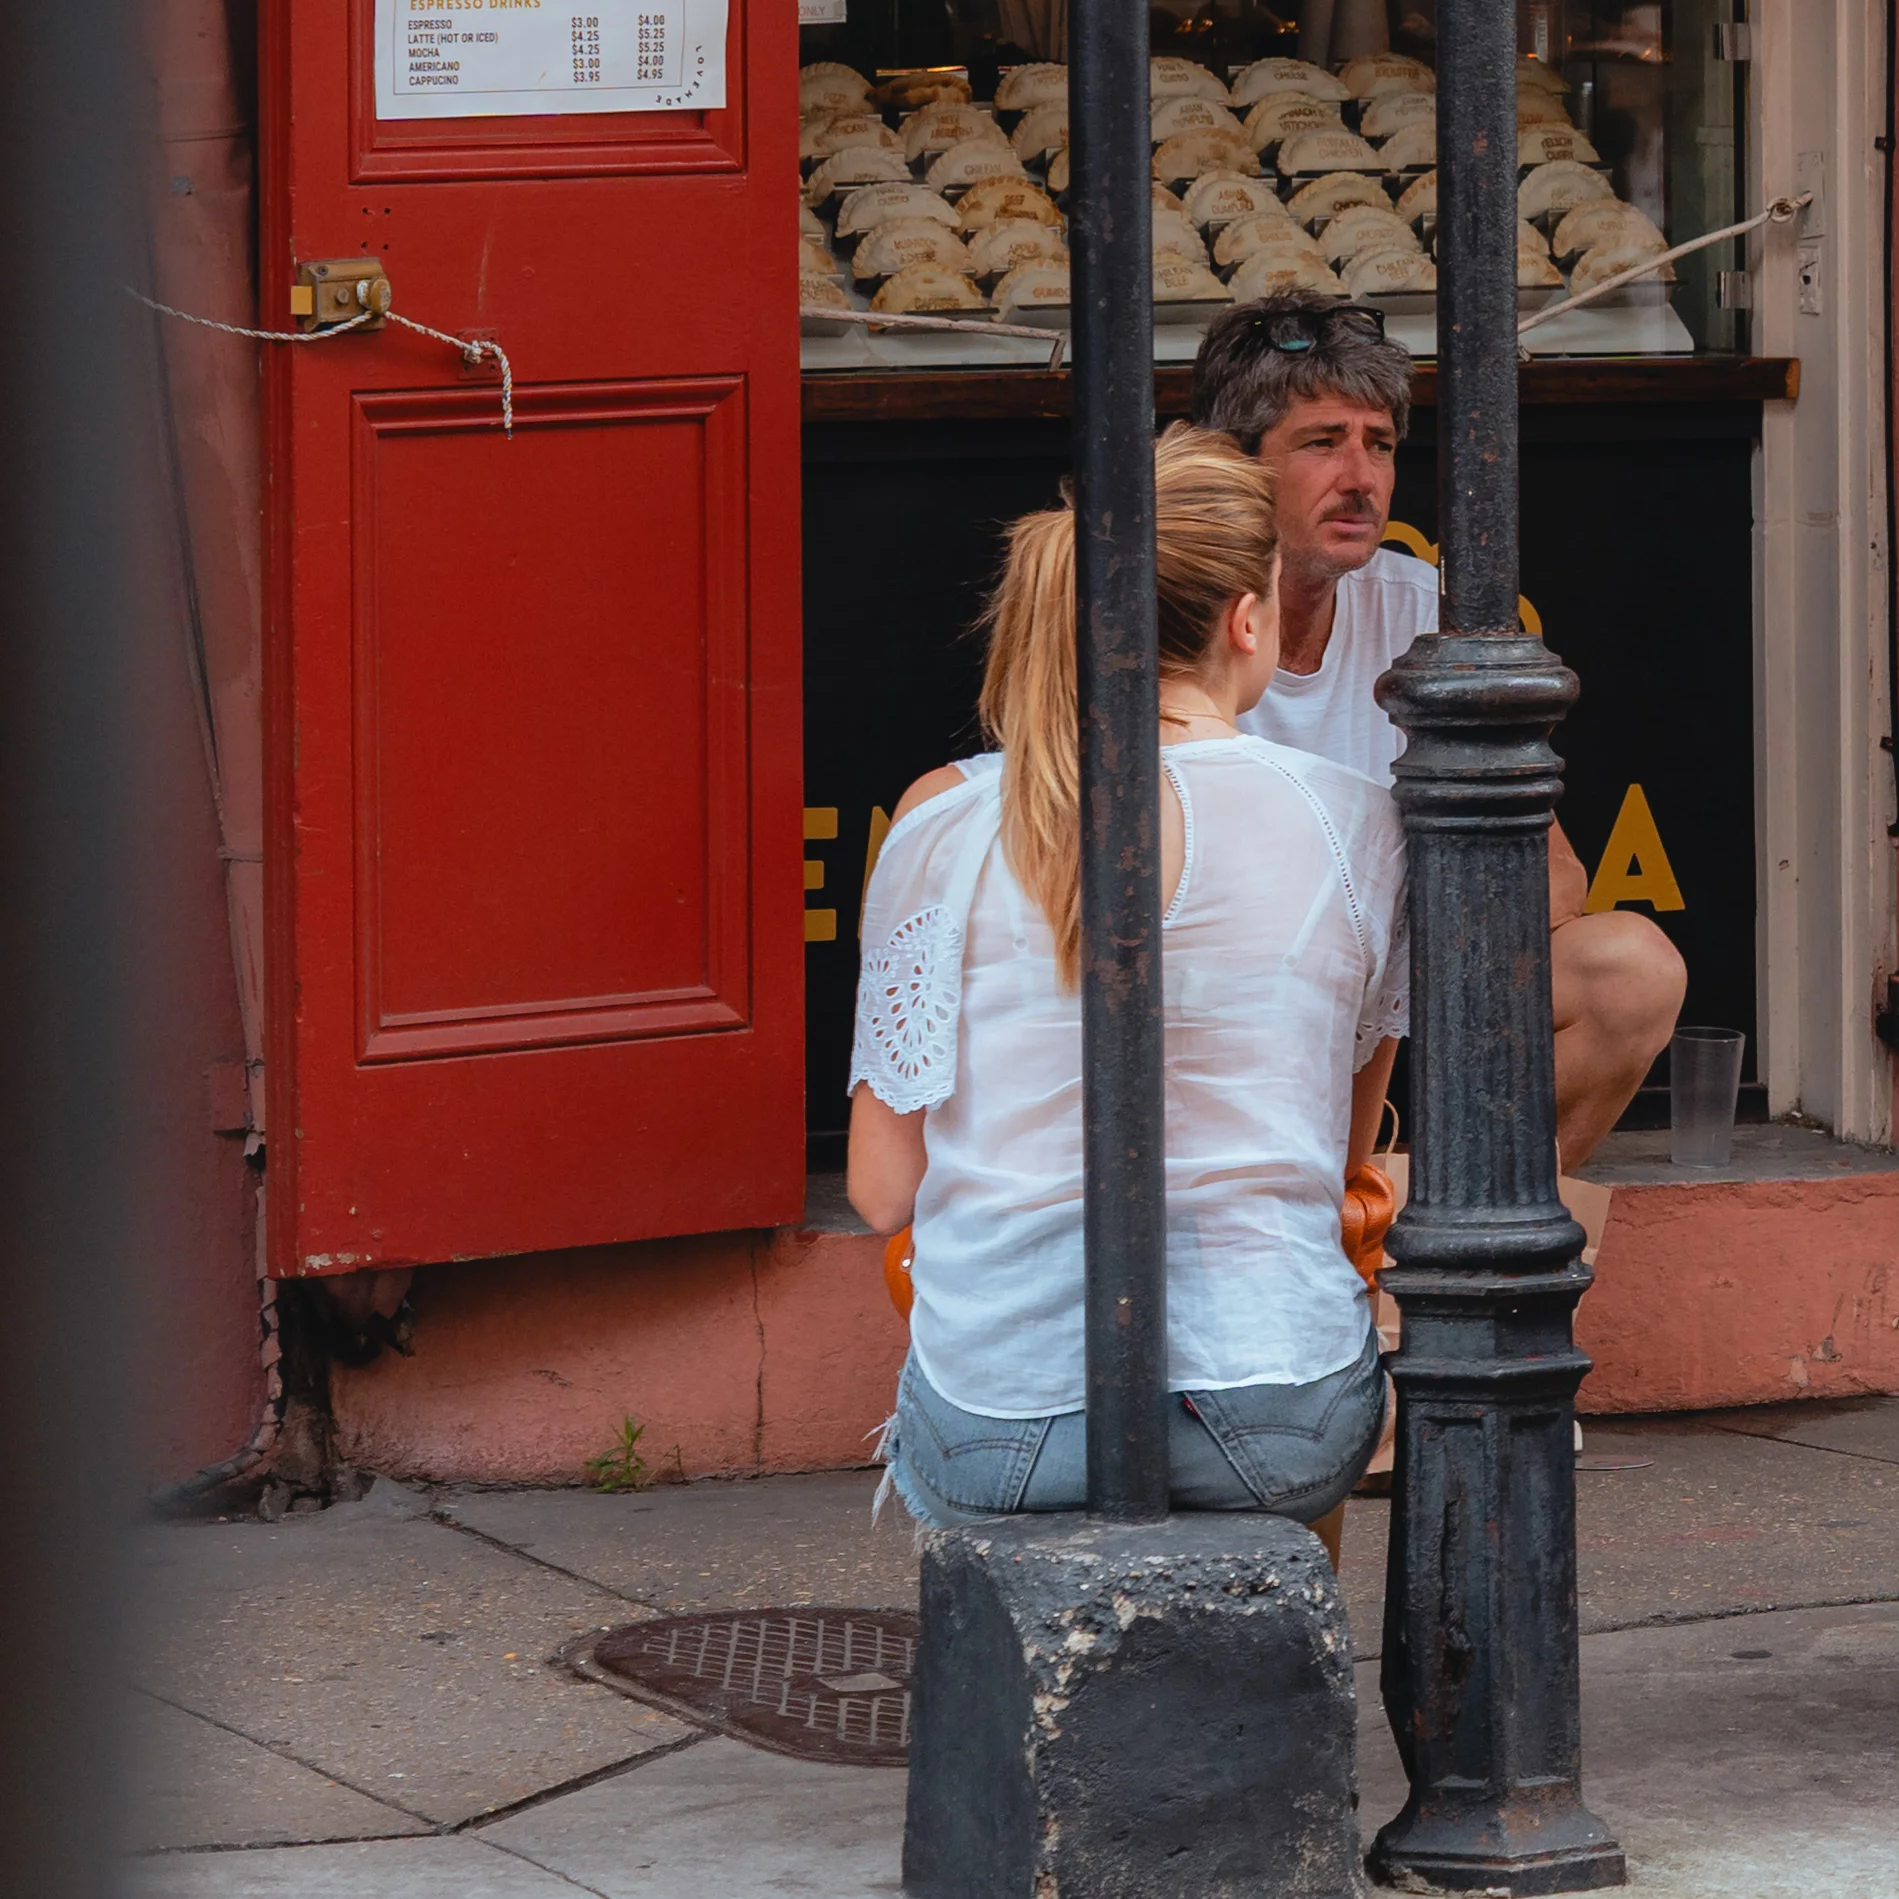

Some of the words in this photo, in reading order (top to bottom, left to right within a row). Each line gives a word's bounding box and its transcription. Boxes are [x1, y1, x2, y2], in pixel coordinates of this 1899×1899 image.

[408, 20, 452, 30] ESPRESSO
[572, 17, 598, 28] $3.00
[638, 14, 664, 26] $4.00
[408, 34, 434, 44] LATTE
[437, 33, 459, 44] (HOT
[462, 33, 473, 43] OR
[476, 32, 498, 43] ICED)
[572, 30, 599, 42] $4.25
[638, 28, 665, 40] $5.25
[409, 48, 439, 57] MOCHA
[572, 44, 600, 55] $4.25
[639, 42, 664, 53] $5.25
[409, 61, 460, 72] AMERICANO
[573, 58, 600, 69] $3.00
[638, 55, 664, 66] $4.00
[409, 75, 458, 85] CAPPUCINO
[574, 71, 600, 83] $3.95
[637, 69, 662, 80] $4.95
